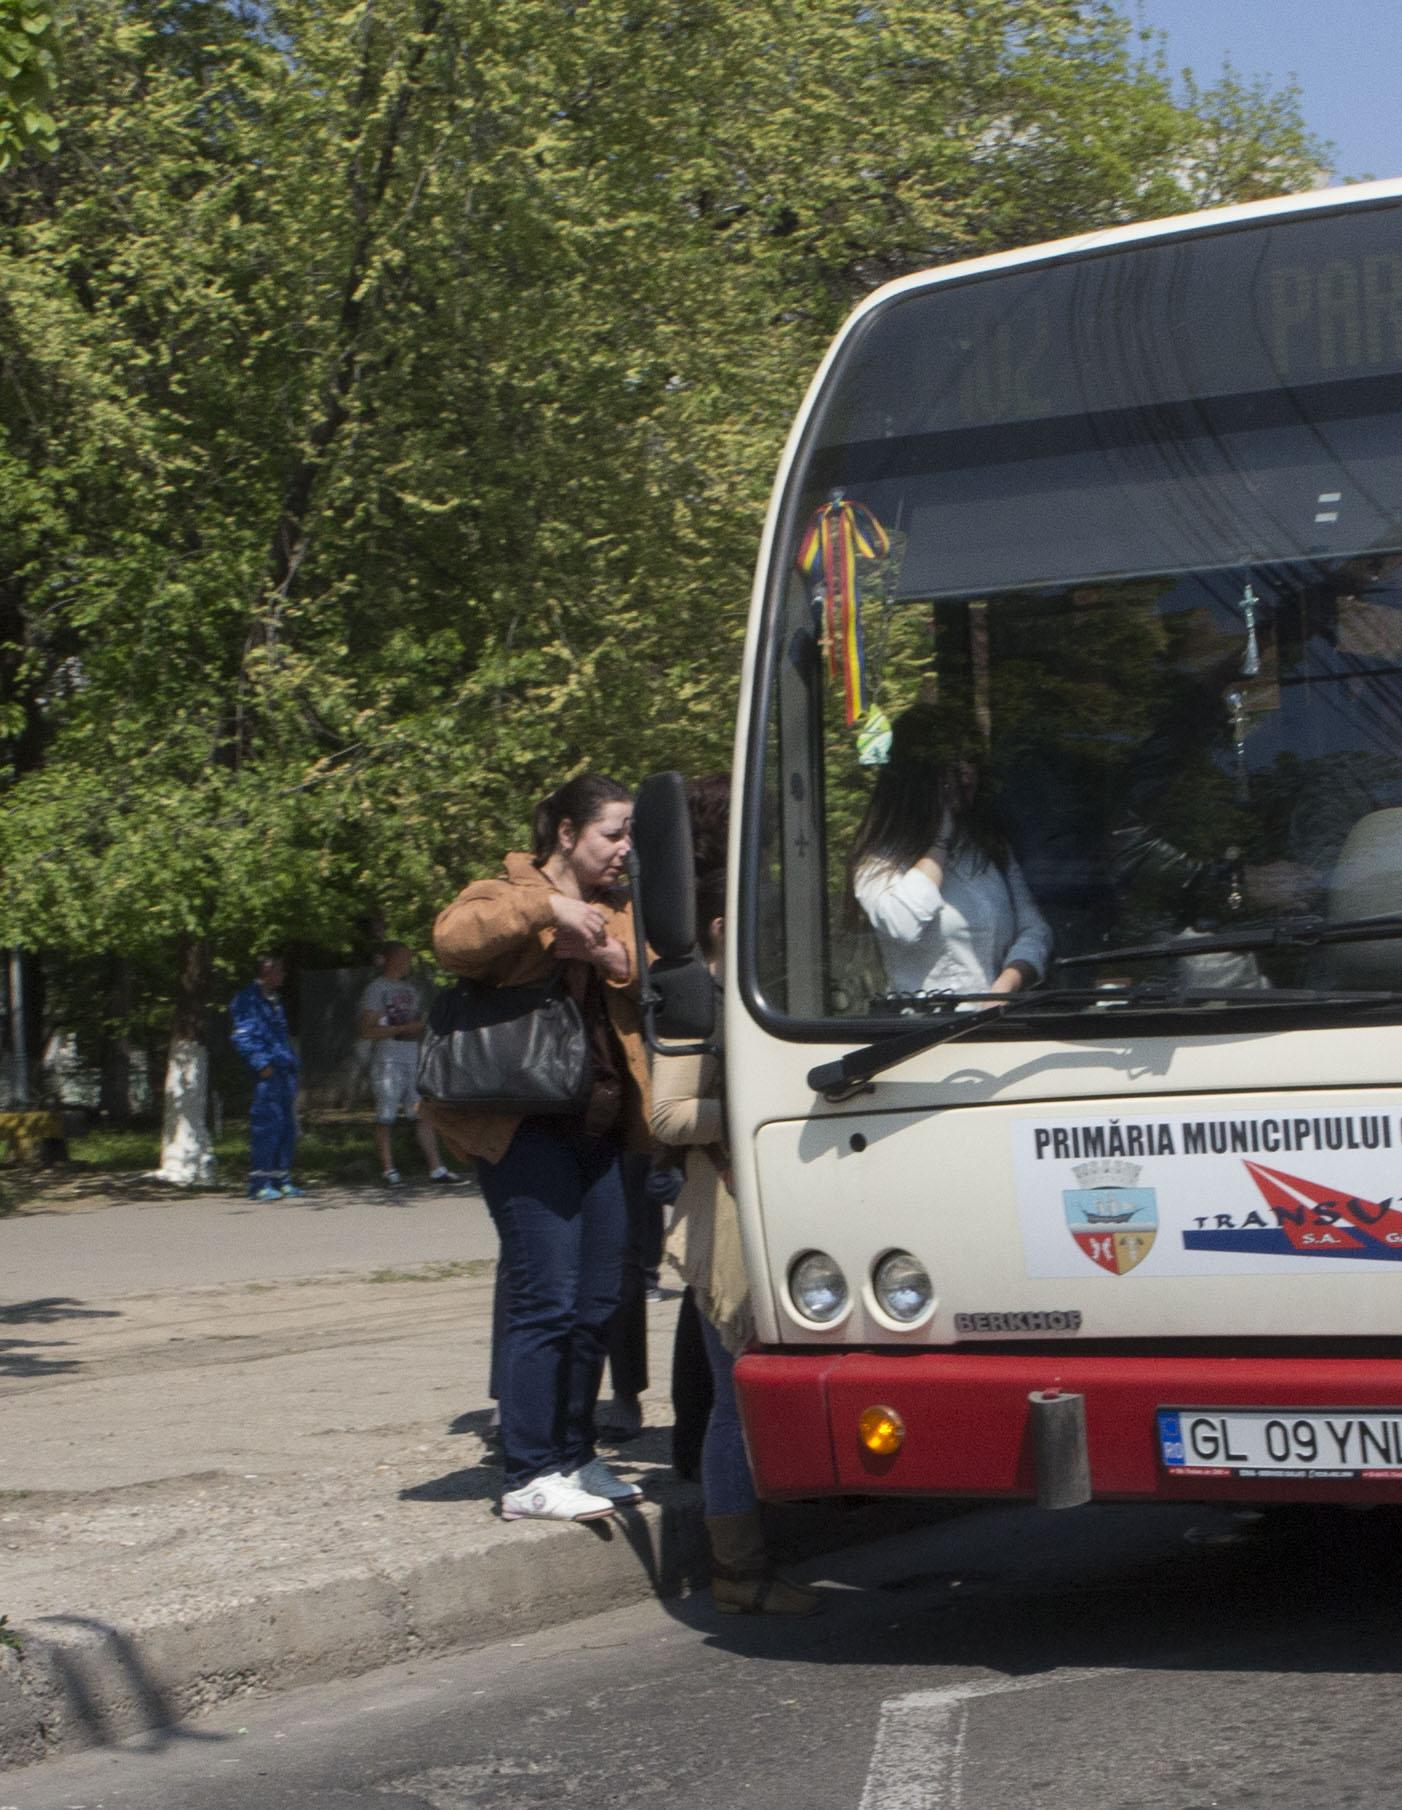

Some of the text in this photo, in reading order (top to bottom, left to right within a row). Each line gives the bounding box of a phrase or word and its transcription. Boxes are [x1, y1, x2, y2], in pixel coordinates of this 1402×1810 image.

[1034, 1117, 1176, 1160] PRIMĂRIA
[1182, 1113, 1393, 1155] MUNICIPIULUI
[954, 1310, 1082, 1332] BERKHOF
[1189, 1418, 1248, 1463] GL
[1264, 1418, 1318, 1463] 09
